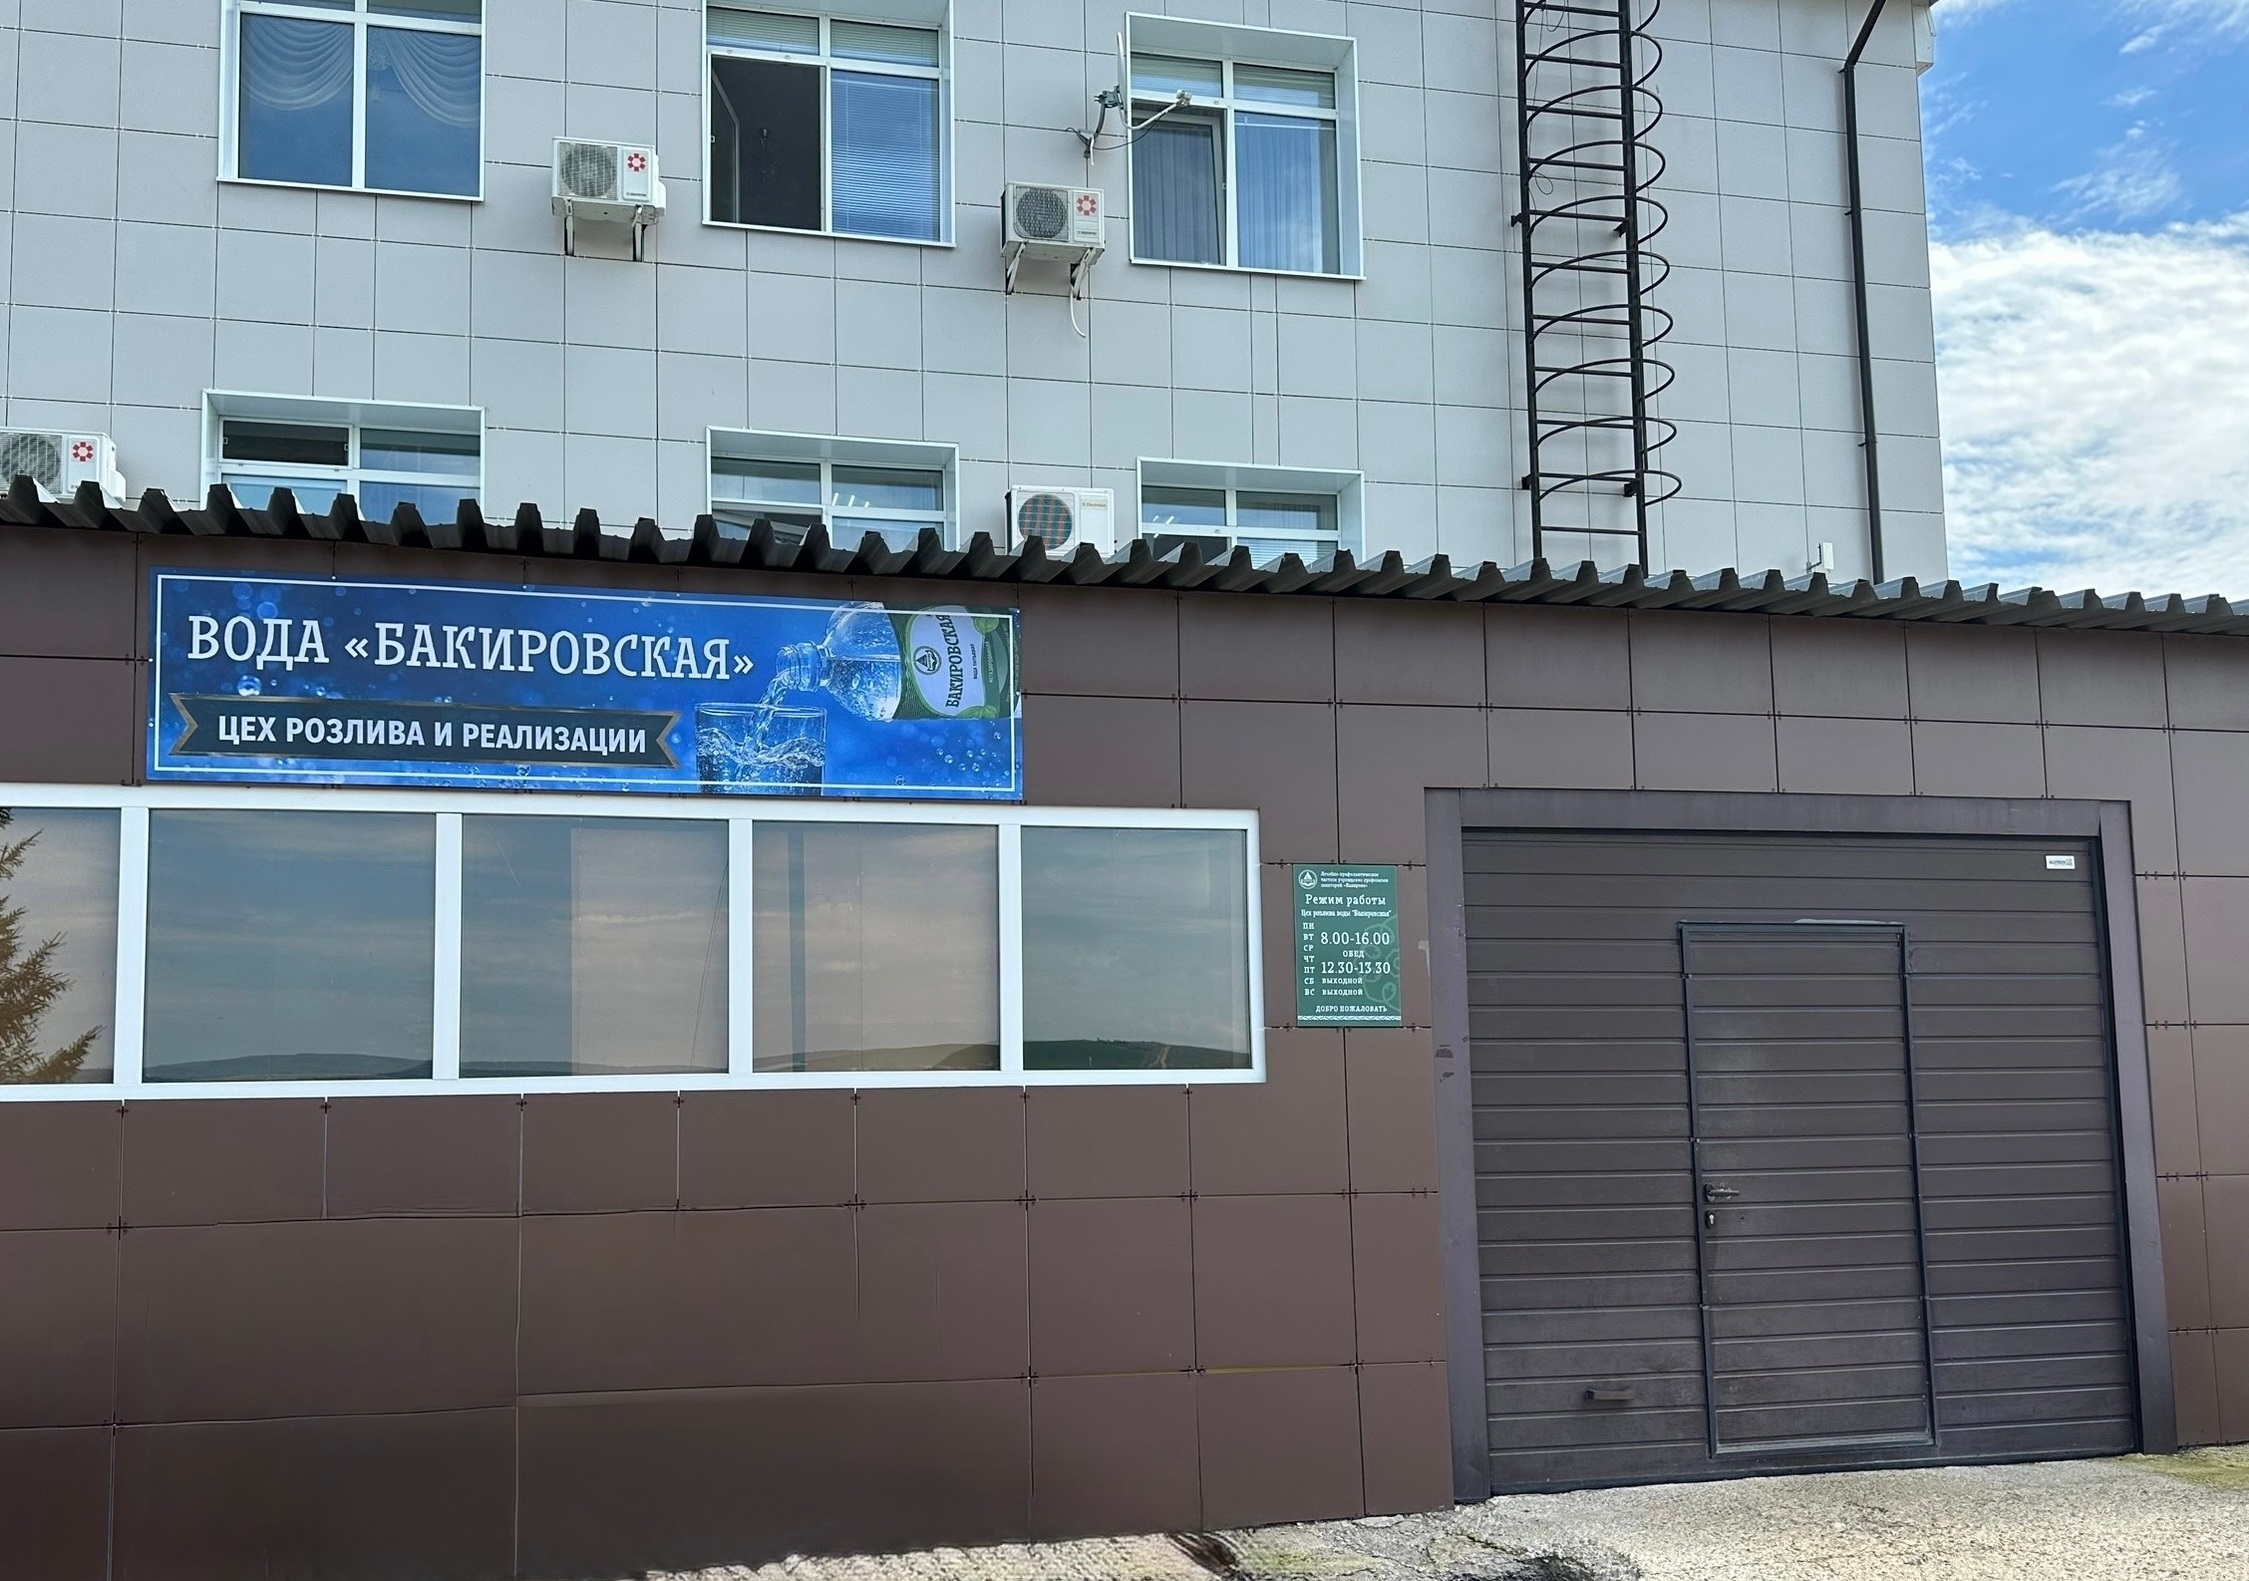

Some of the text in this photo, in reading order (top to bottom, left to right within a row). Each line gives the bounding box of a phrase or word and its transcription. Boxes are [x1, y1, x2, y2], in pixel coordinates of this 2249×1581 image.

[187, 615, 755, 680] ВОДА «БАКИРОВСКАЯ»
[936, 614, 964, 708] БАКИРОВСКАЯ
[218, 715, 646, 756] ЦЕХ РОЗЛИВА И РЕАЛИЗАЦИИ
[1305, 893, 1386, 907] Режим работы
[1302, 922, 1315, 930] ПН
[1303, 933, 1314, 941] ВТ
[1320, 931, 1390, 945] 8.00-16.00
[1303, 944, 1314, 952] СР
[1342, 950, 1365, 958] ОБЕД
[1303, 955, 1315, 963] ЧТ
[1303, 966, 1315, 974] ПТ
[1321, 961, 1391, 974] 12.30-13.30
[1303, 977, 1315, 985] СБ
[1304, 988, 1315, 996] ВС
[1315, 1005, 1388, 1013] ДОБРО ПОЖАЛОВАТЬ
